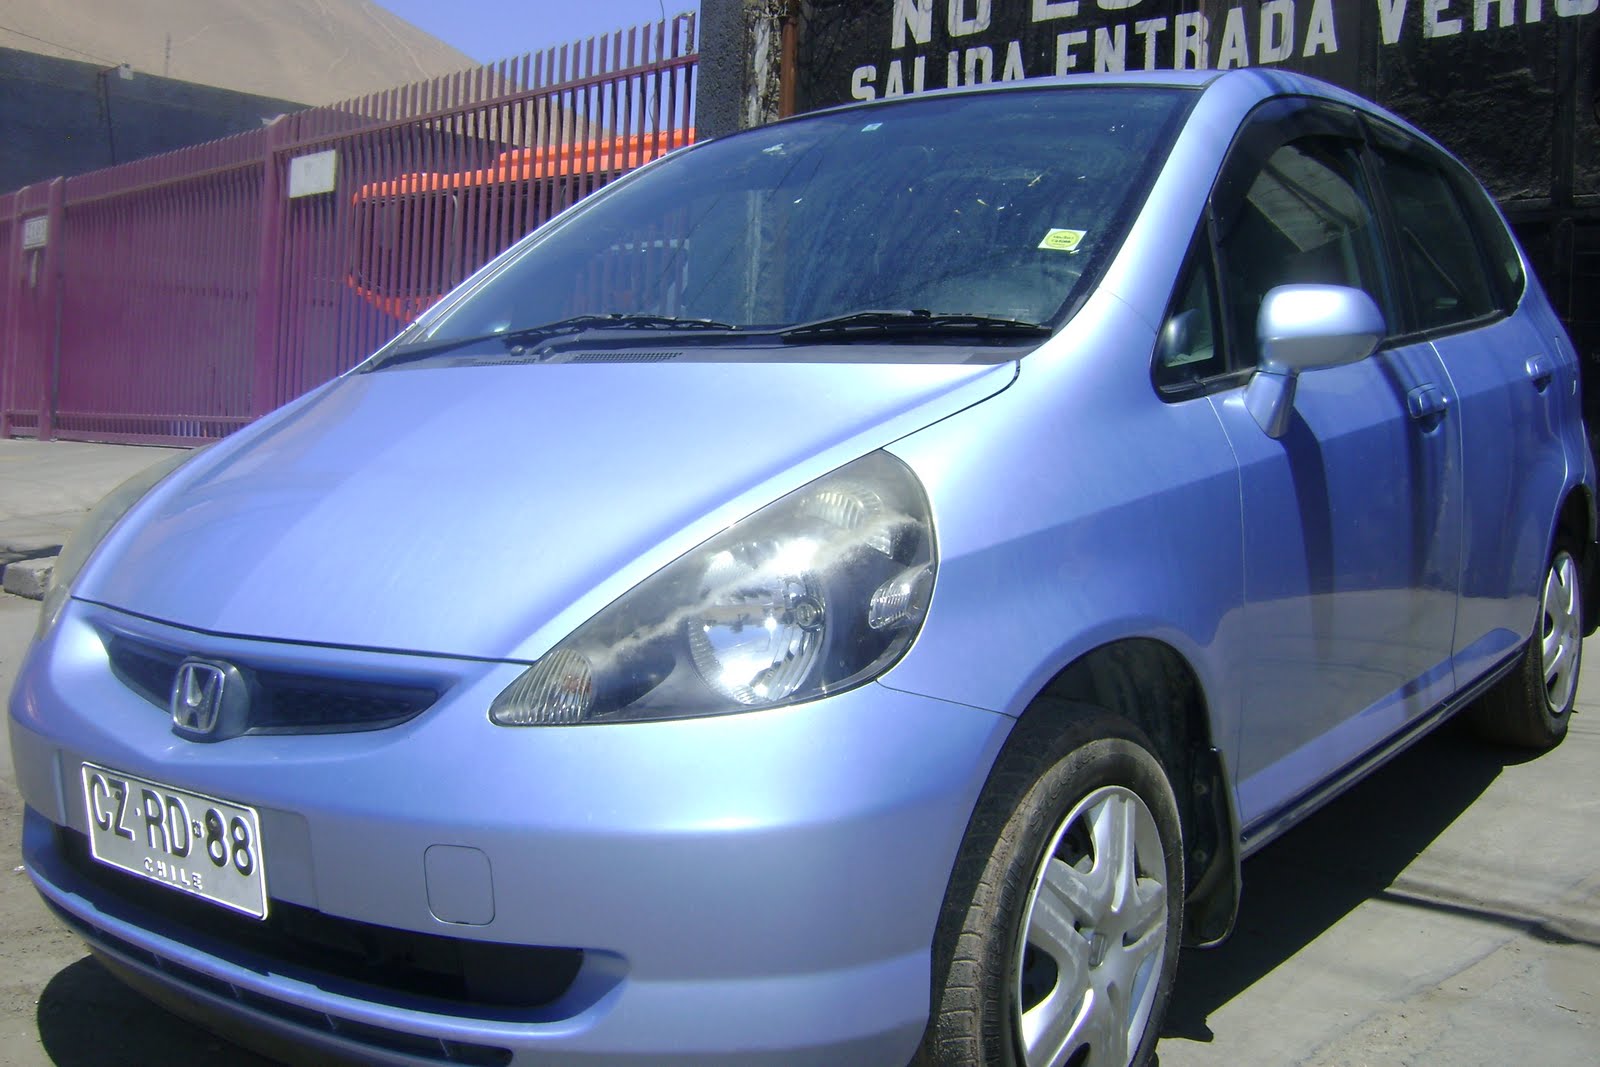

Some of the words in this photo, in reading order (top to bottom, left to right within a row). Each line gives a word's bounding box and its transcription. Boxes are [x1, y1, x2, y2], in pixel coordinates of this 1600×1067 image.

[851, 40, 1026, 101] SALIDA
[1055, 0, 1338, 77] ENTRADA
[143, 857, 203, 890] CHILE
